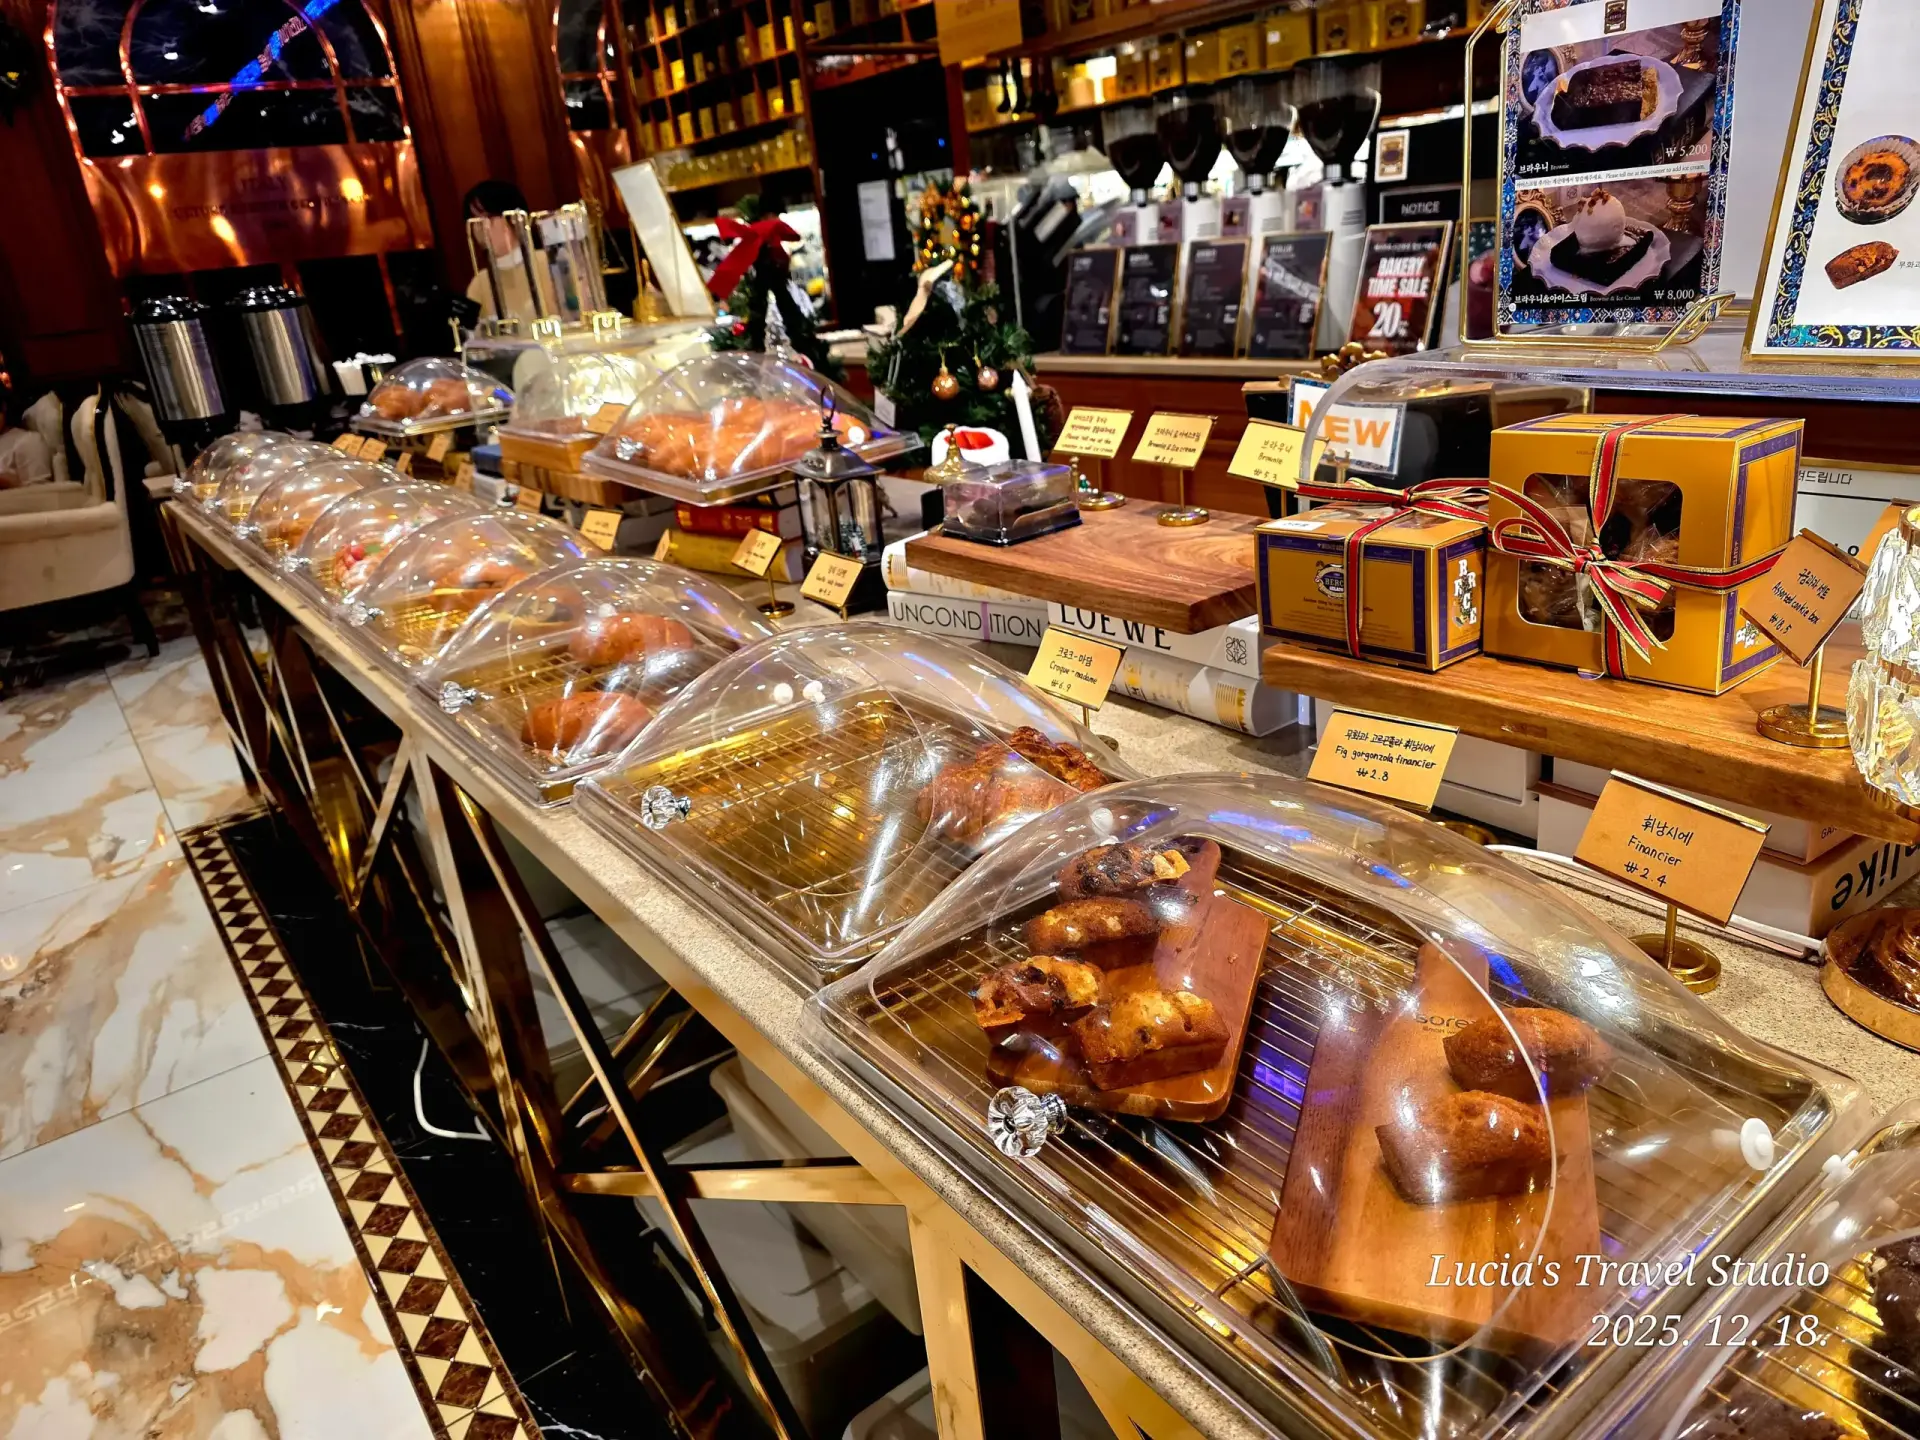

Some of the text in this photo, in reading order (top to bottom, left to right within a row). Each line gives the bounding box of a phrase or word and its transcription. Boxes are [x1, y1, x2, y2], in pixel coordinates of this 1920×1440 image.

[1518, 162, 1548, 174] 브라우니
[1401, 201, 1440, 215] NOTICE
[1377, 256, 1427, 276] BAKERY
[1367, 276, 1430, 298] TIME SALE
[1298, 400, 1391, 448] NEW
[1258, 452, 1283, 464] Brownie
[1260, 440, 1294, 454] 브라우니
[1324, 577, 1345, 588] BERC
[1772, 581, 1820, 624] Assorted cookie box
[1060, 603, 1172, 650] LOEWE
[1344, 728, 1369, 742] 무화과
[1404, 738, 1436, 753] 휘낭시에
[1335, 745, 1437, 770] Fig gorgonzola financier
[1640, 814, 1694, 847] 휘낭시에
[1627, 834, 1682, 867] Financier
[1416, 1014, 1477, 1029] sore
